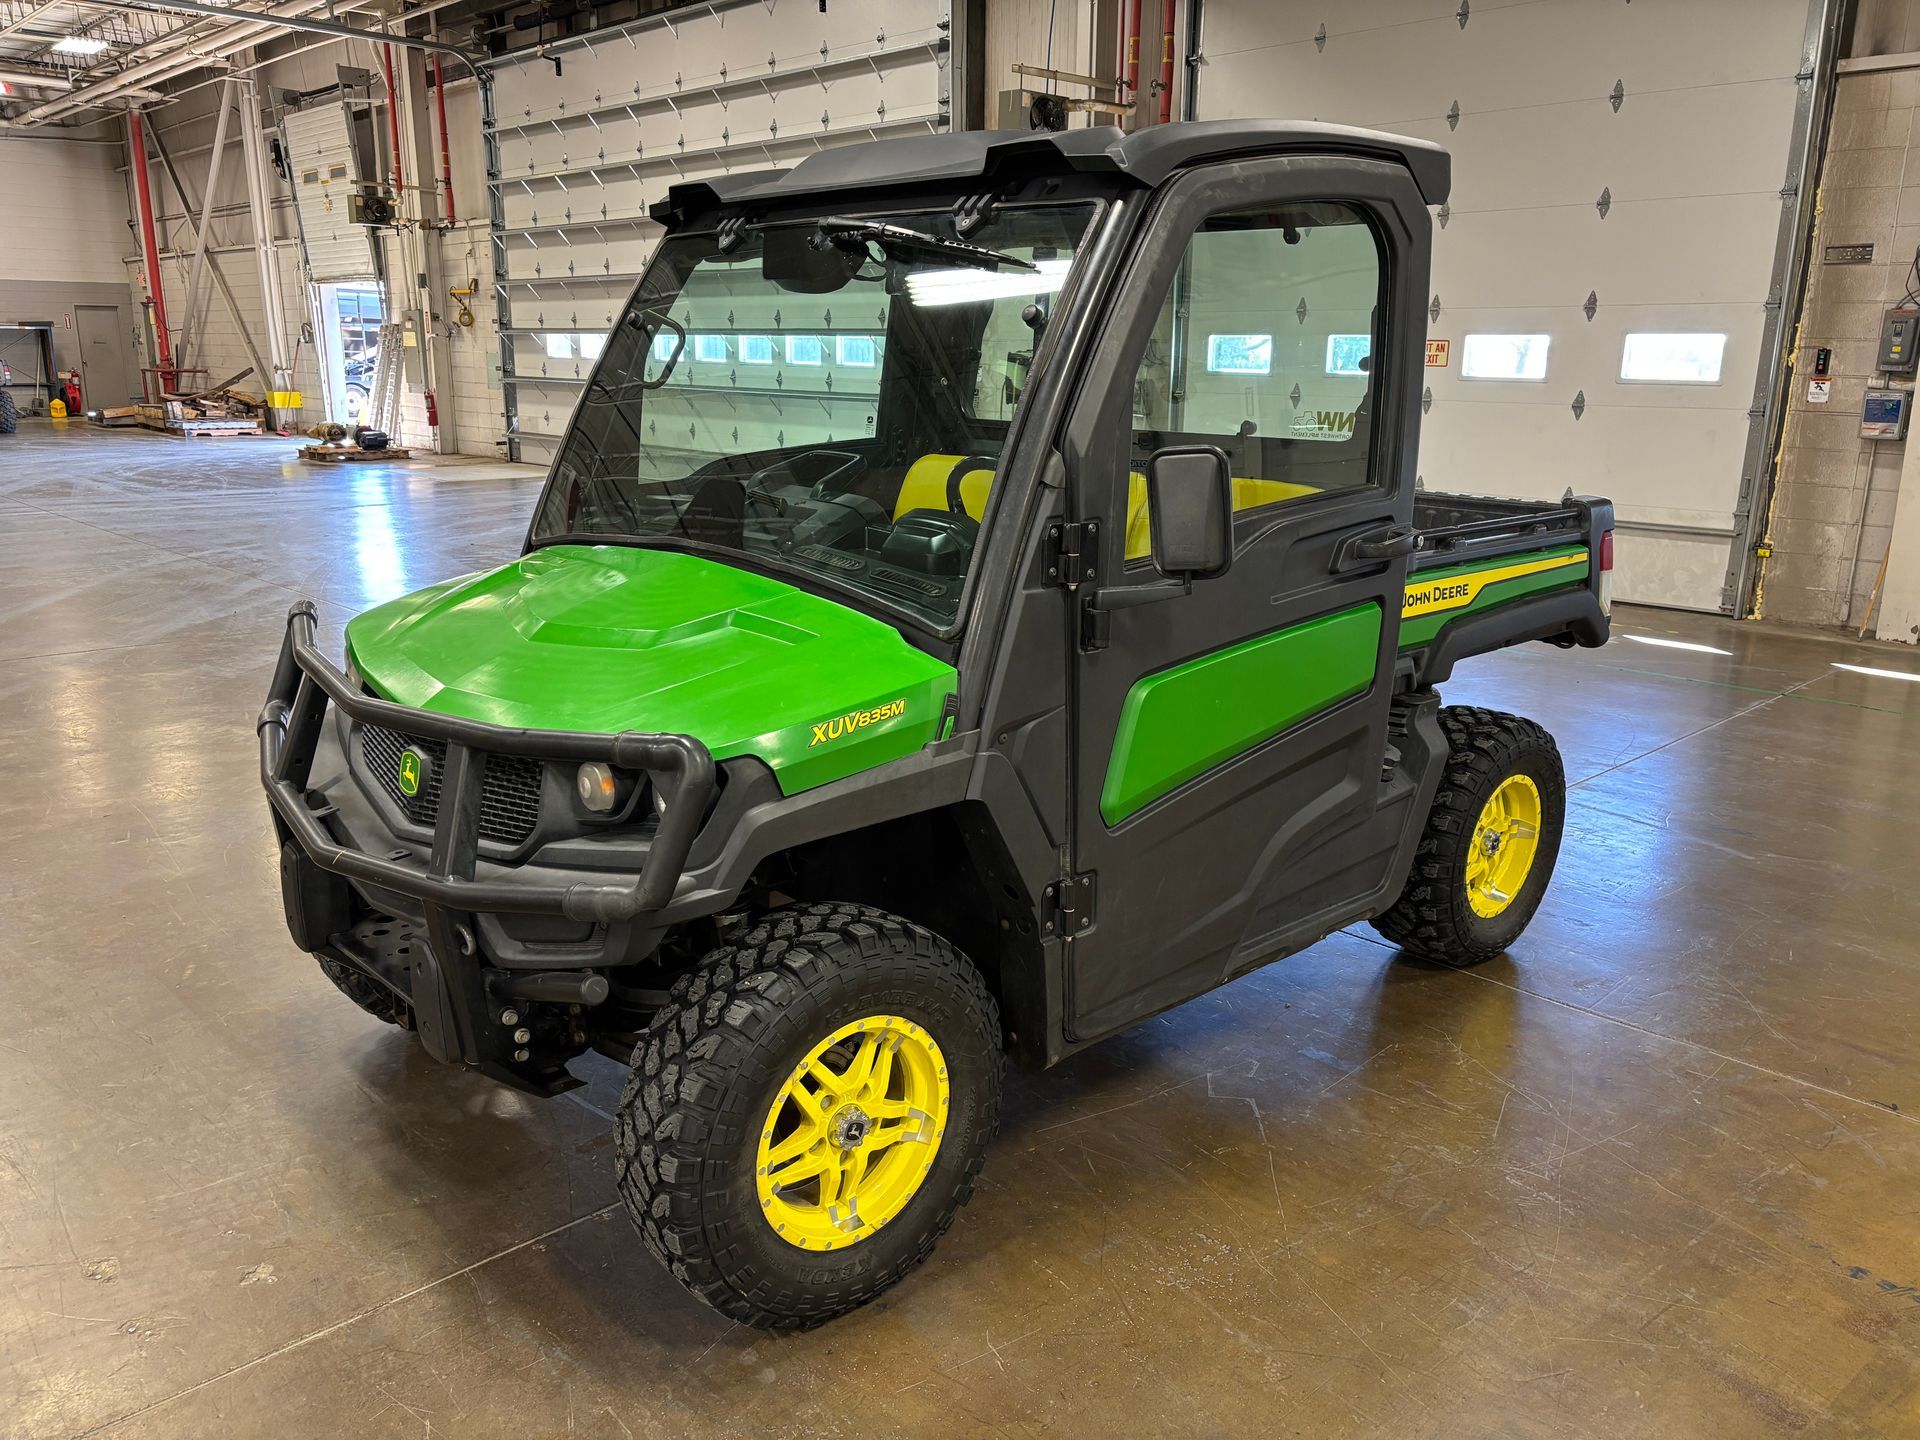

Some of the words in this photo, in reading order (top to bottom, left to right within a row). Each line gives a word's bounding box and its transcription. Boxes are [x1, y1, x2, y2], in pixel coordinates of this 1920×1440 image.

[1435, 343, 1446, 353] AN
[1402, 590, 1431, 608] JOHN
[1433, 584, 1469, 602] DEERE
[808, 699, 906, 748] XUV835M
